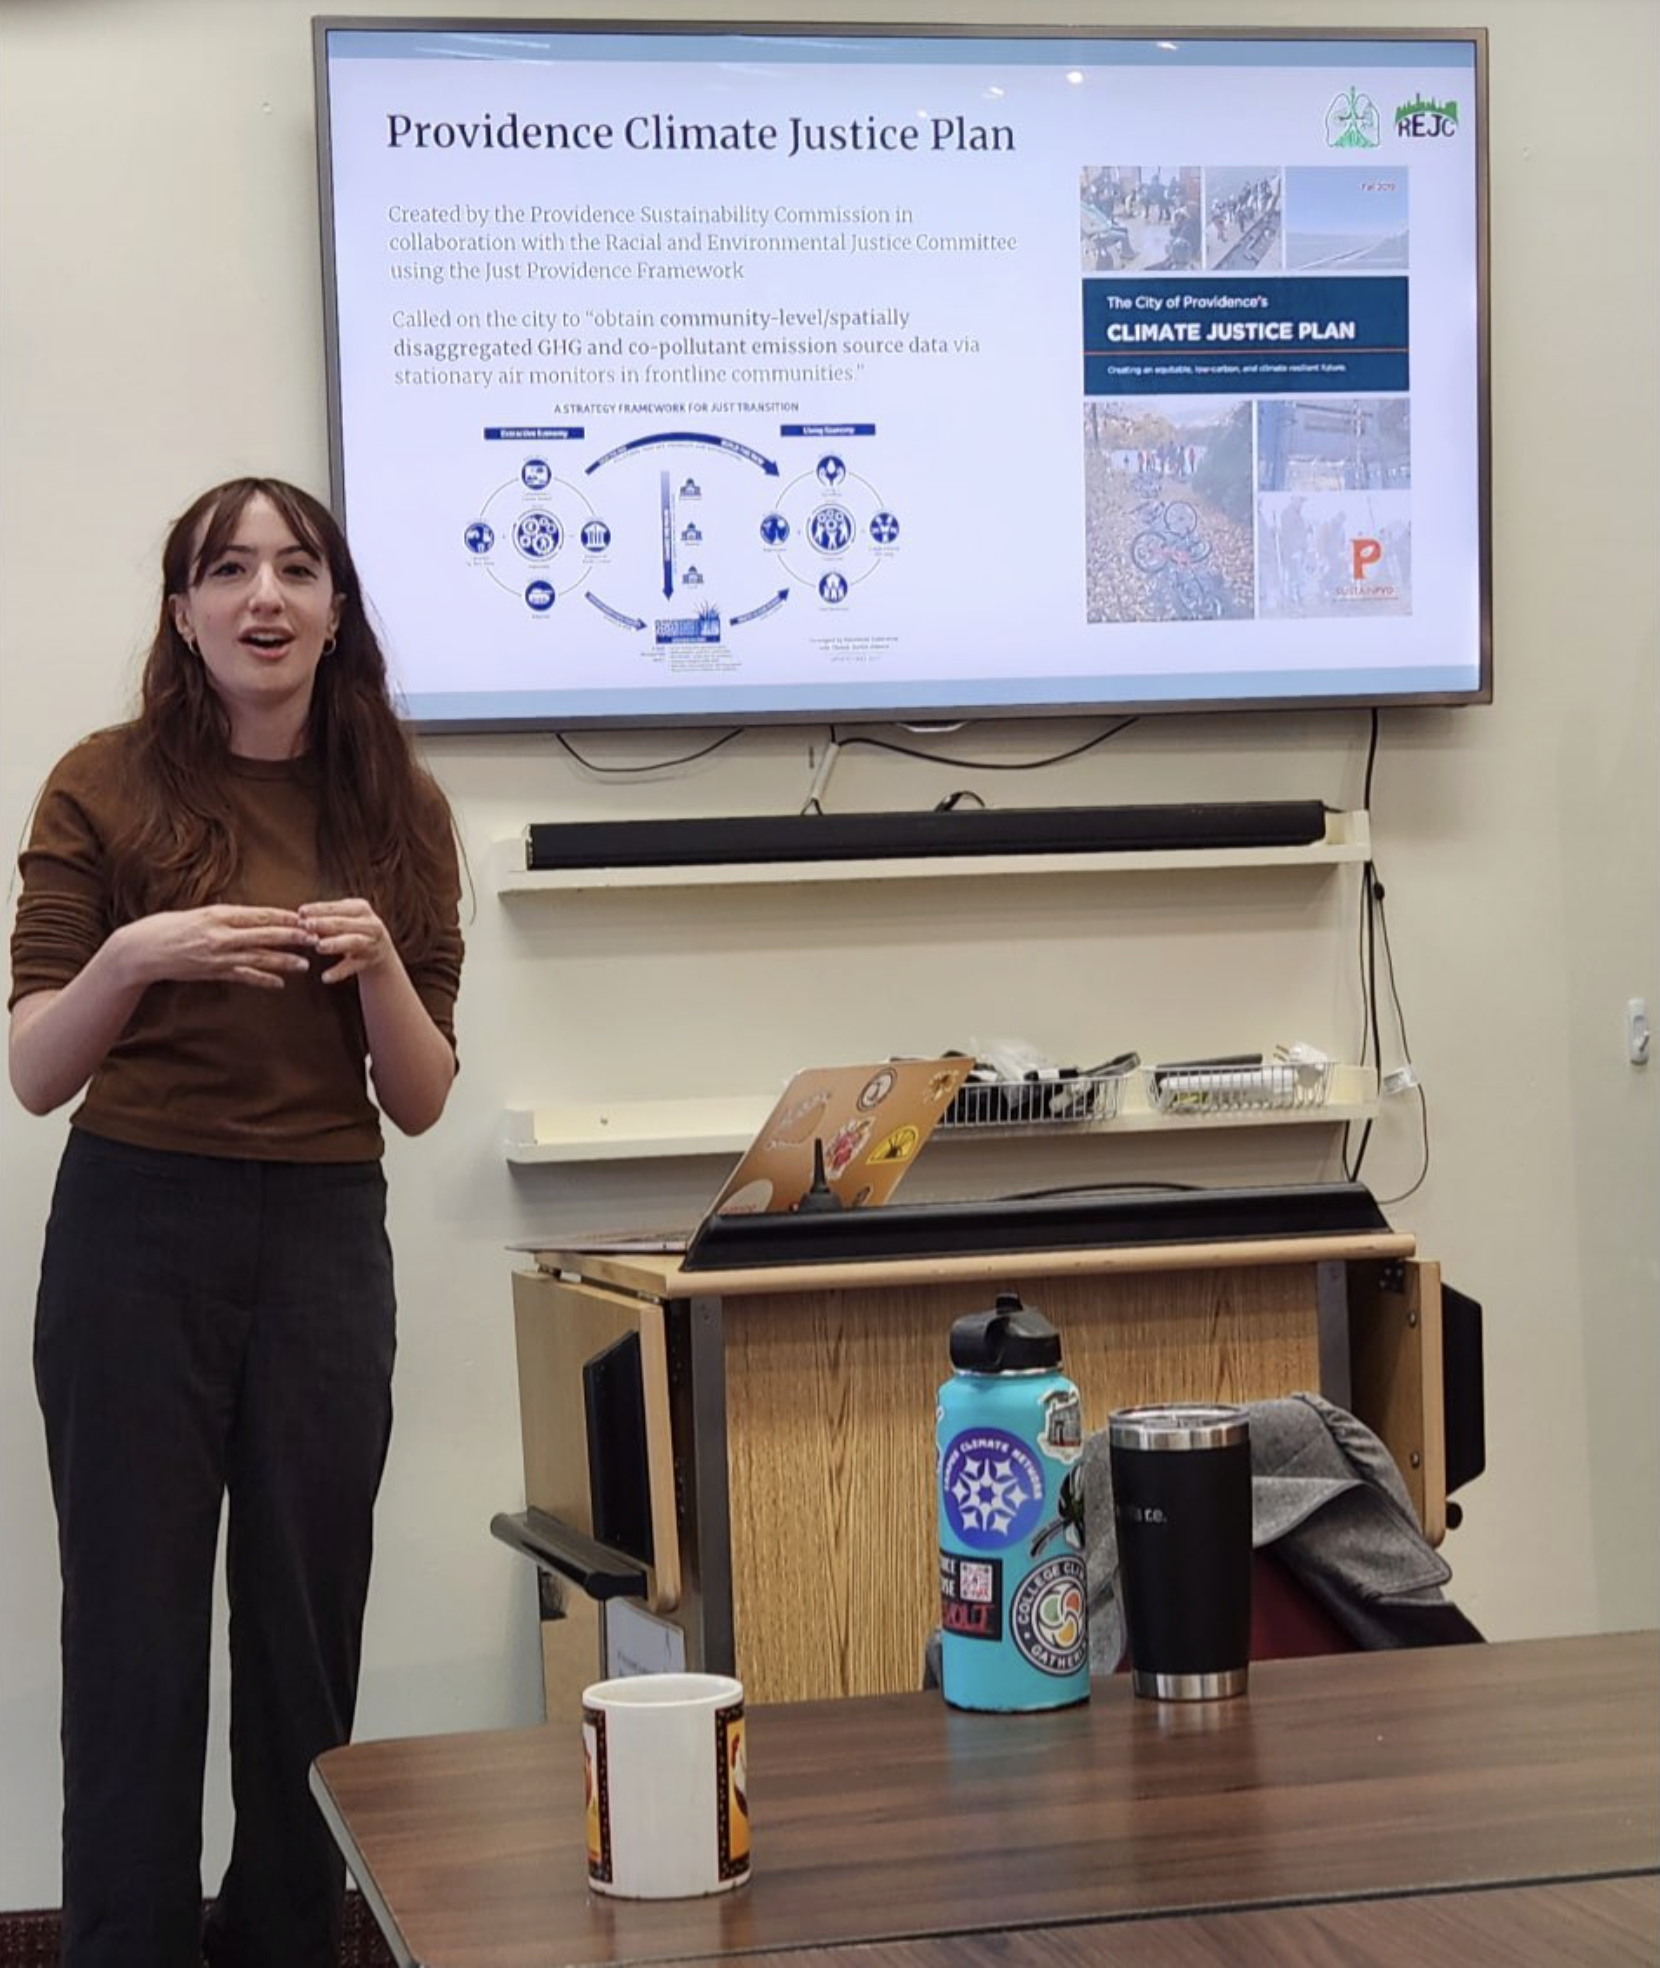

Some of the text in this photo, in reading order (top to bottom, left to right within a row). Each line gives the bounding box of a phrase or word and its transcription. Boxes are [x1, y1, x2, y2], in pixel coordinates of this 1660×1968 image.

[388, 113, 1014, 157] Providence Climate Justice Plan
[1398, 113, 1455, 137] REJC
[388, 204, 912, 228] Created by the Providence Sustainability Commission in
[388, 232, 1017, 253] collaboration with the Racial and Environmental Justice Committee
[390, 261, 743, 284] using the Just Providence Framework
[1107, 295, 1268, 311] The City of Providence's
[393, 309, 451, 328] Called
[457, 314, 480, 328] on
[487, 310, 517, 328] the
[522, 311, 557, 332] city
[562, 313, 580, 327] to
[660, 308, 909, 330] community-level/spatially
[1107, 322, 1355, 341] CLIMATE JUSTICE PLAN
[394, 336, 979, 361] disaggregated GHG and co-pollutant emission source data via
[395, 367, 492, 388] stationary
[499, 367, 523, 384] air
[529, 367, 614, 384] monitors
[621, 367, 640, 383] in
[646, 365, 726, 382] frontline
[554, 402, 799, 414] A STRATEGY FRAMEWORK FOR JUST TRANSITION
[959, 1438, 1010, 1453] CLIMATE
[1018, 1564, 1060, 1624] COLLEGE
